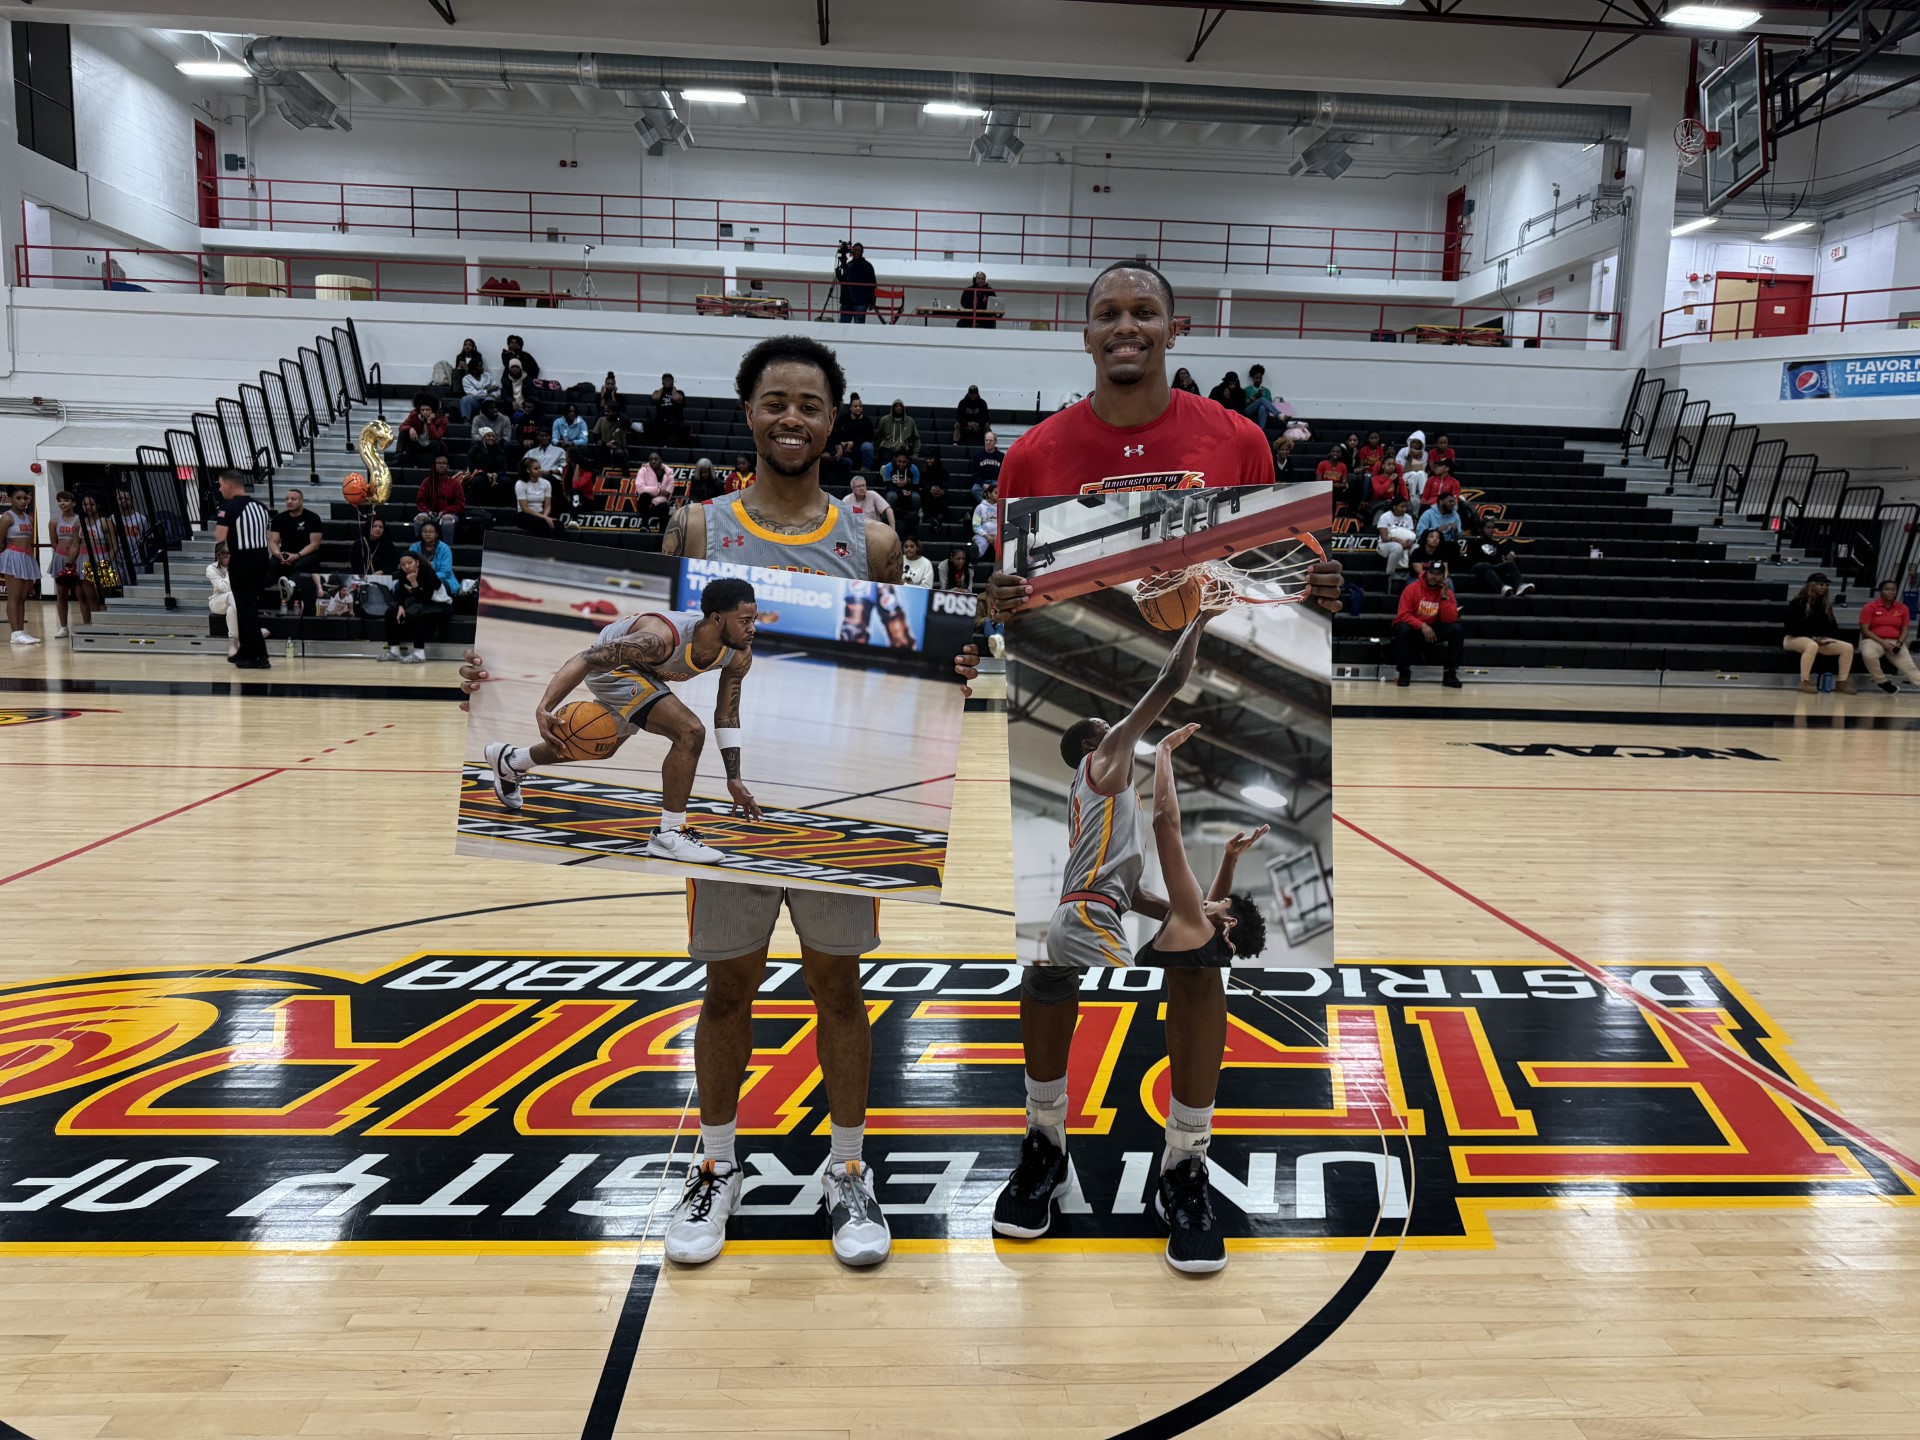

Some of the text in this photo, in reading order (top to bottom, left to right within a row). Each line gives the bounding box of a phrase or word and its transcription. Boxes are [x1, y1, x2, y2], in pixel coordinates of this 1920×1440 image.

[1763, 255, 1775, 266] EXIT
[1846, 360, 1911, 373] FLAVOR
[1819, 369, 1829, 389] pepsi
[1845, 372, 1920, 386] THE FIRE
[1104, 477, 1151, 489] UNIVERSITY
[1153, 477, 1162, 485] OF
[1165, 475, 1179, 483] THE
[559, 512, 629, 528] DSTRICT
[688, 557, 749, 580] MADE
[751, 563, 793, 587] FOR
[1468, 742, 1782, 762] NCAA
[0, 1157, 221, 1213] OF
